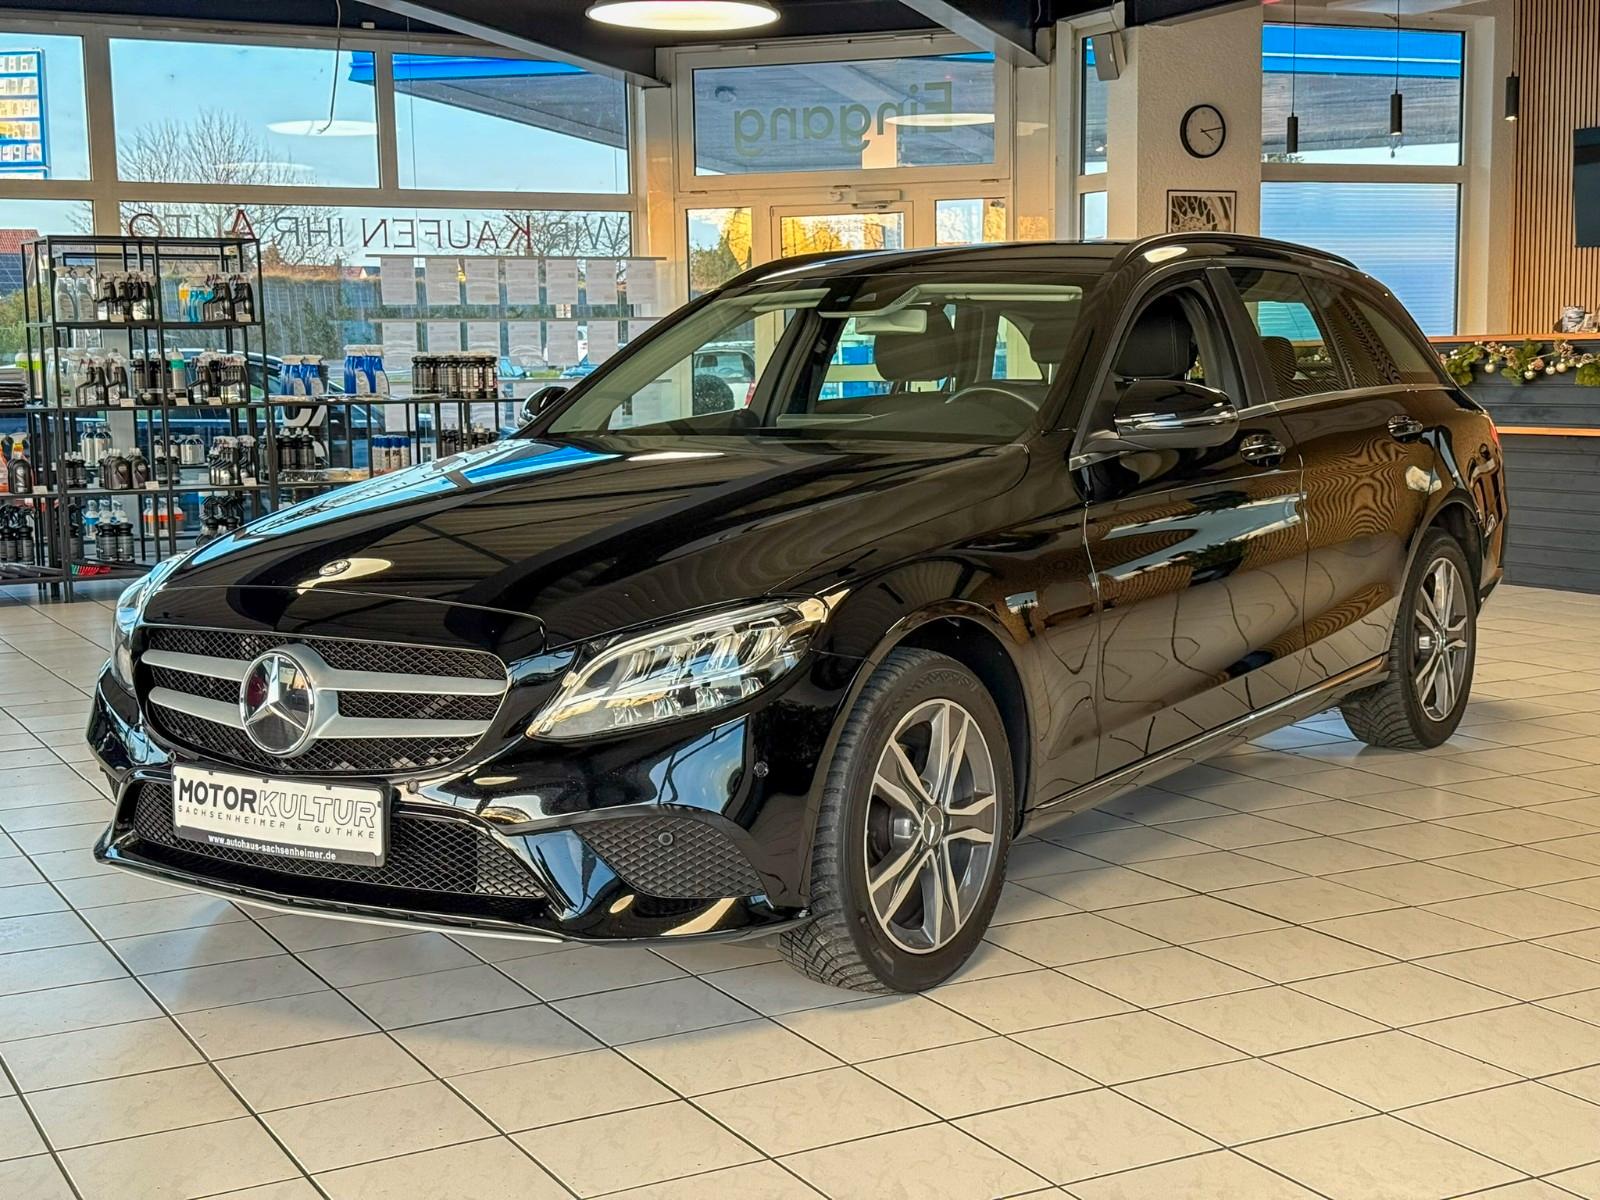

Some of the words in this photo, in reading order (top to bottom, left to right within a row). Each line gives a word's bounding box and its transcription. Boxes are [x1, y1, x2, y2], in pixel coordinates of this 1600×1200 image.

[178, 805, 286, 829] SACHSENHEIMER
[296, 823, 303, 832] &
[314, 825, 375, 839] GUTHKE
[207, 834, 337, 861] www.autohaus-sachsenheimer.de
